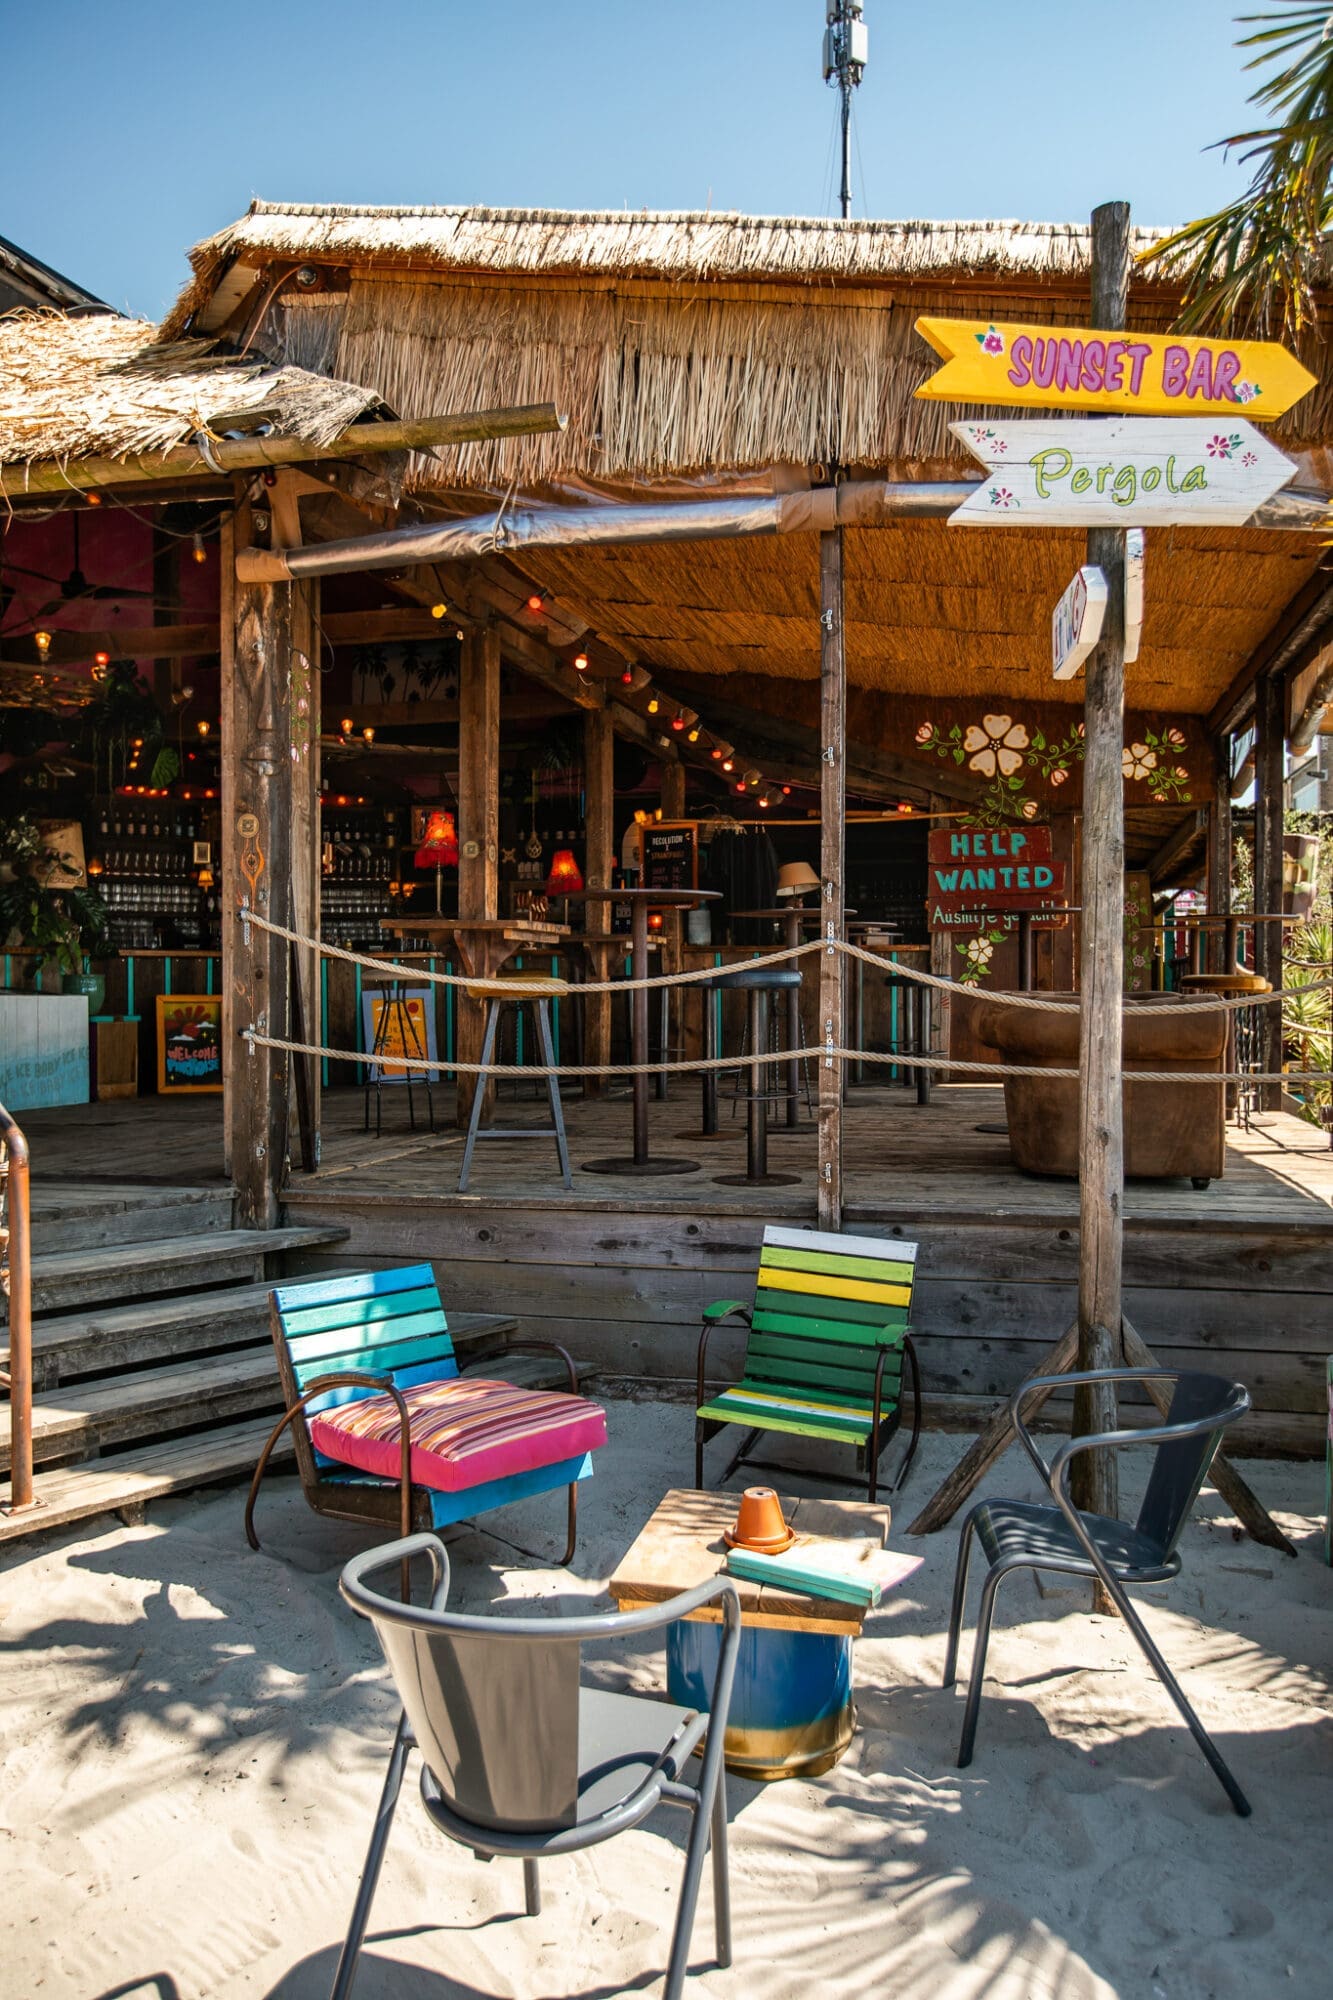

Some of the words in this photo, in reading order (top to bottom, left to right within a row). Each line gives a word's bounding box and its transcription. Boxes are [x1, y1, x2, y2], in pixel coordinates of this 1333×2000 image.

[1007, 334, 1152, 397] SUNSET
[1161, 345, 1242, 402] BAR
[1029, 447, 1208, 507] Pergola
[950, 832, 1026, 857] HELP
[934, 866, 1054, 892] WANTED
[167, 1046, 218, 1061] WELCOME
